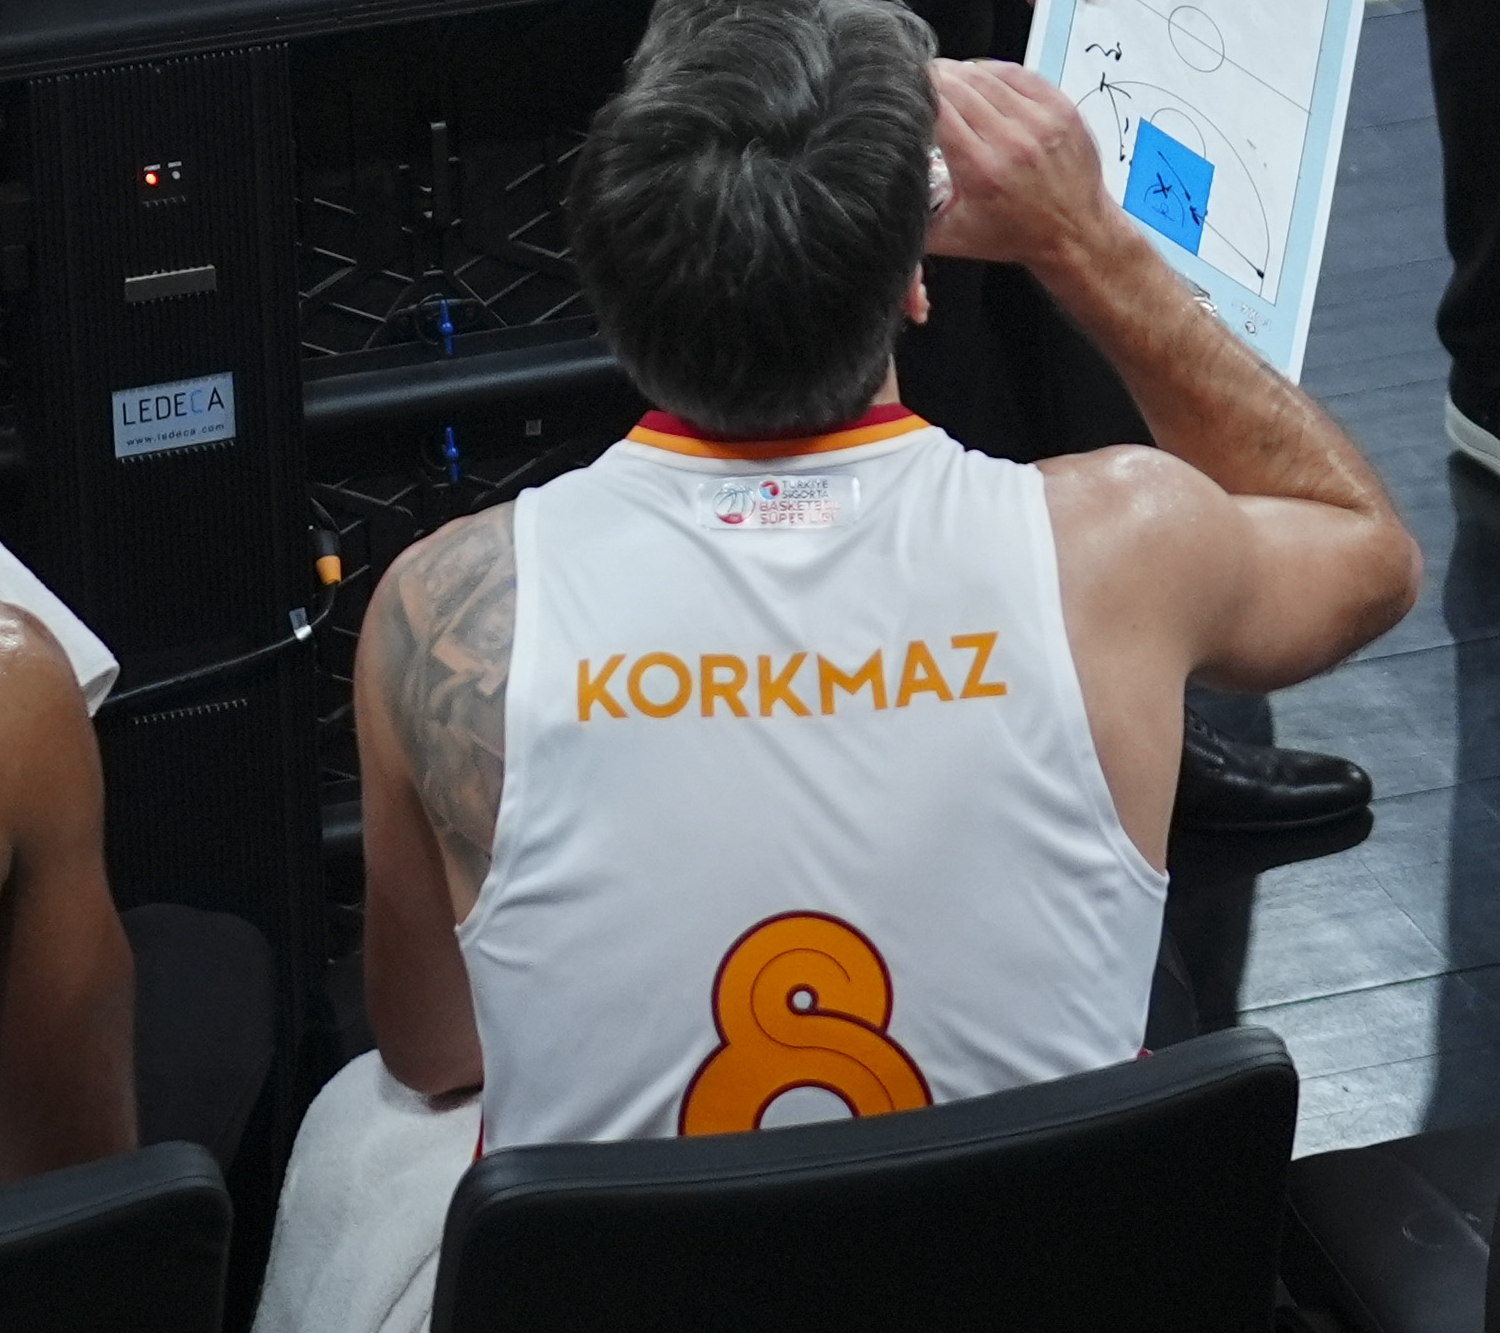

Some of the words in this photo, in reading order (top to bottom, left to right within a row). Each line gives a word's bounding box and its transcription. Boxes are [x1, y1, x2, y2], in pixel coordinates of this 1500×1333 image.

[122, 386, 225, 426] LEDECA
[126, 424, 225, 446] www.ledeca.com
[578, 630, 1008, 723] KORKMAZ
[677, 912, 935, 1137] 8
